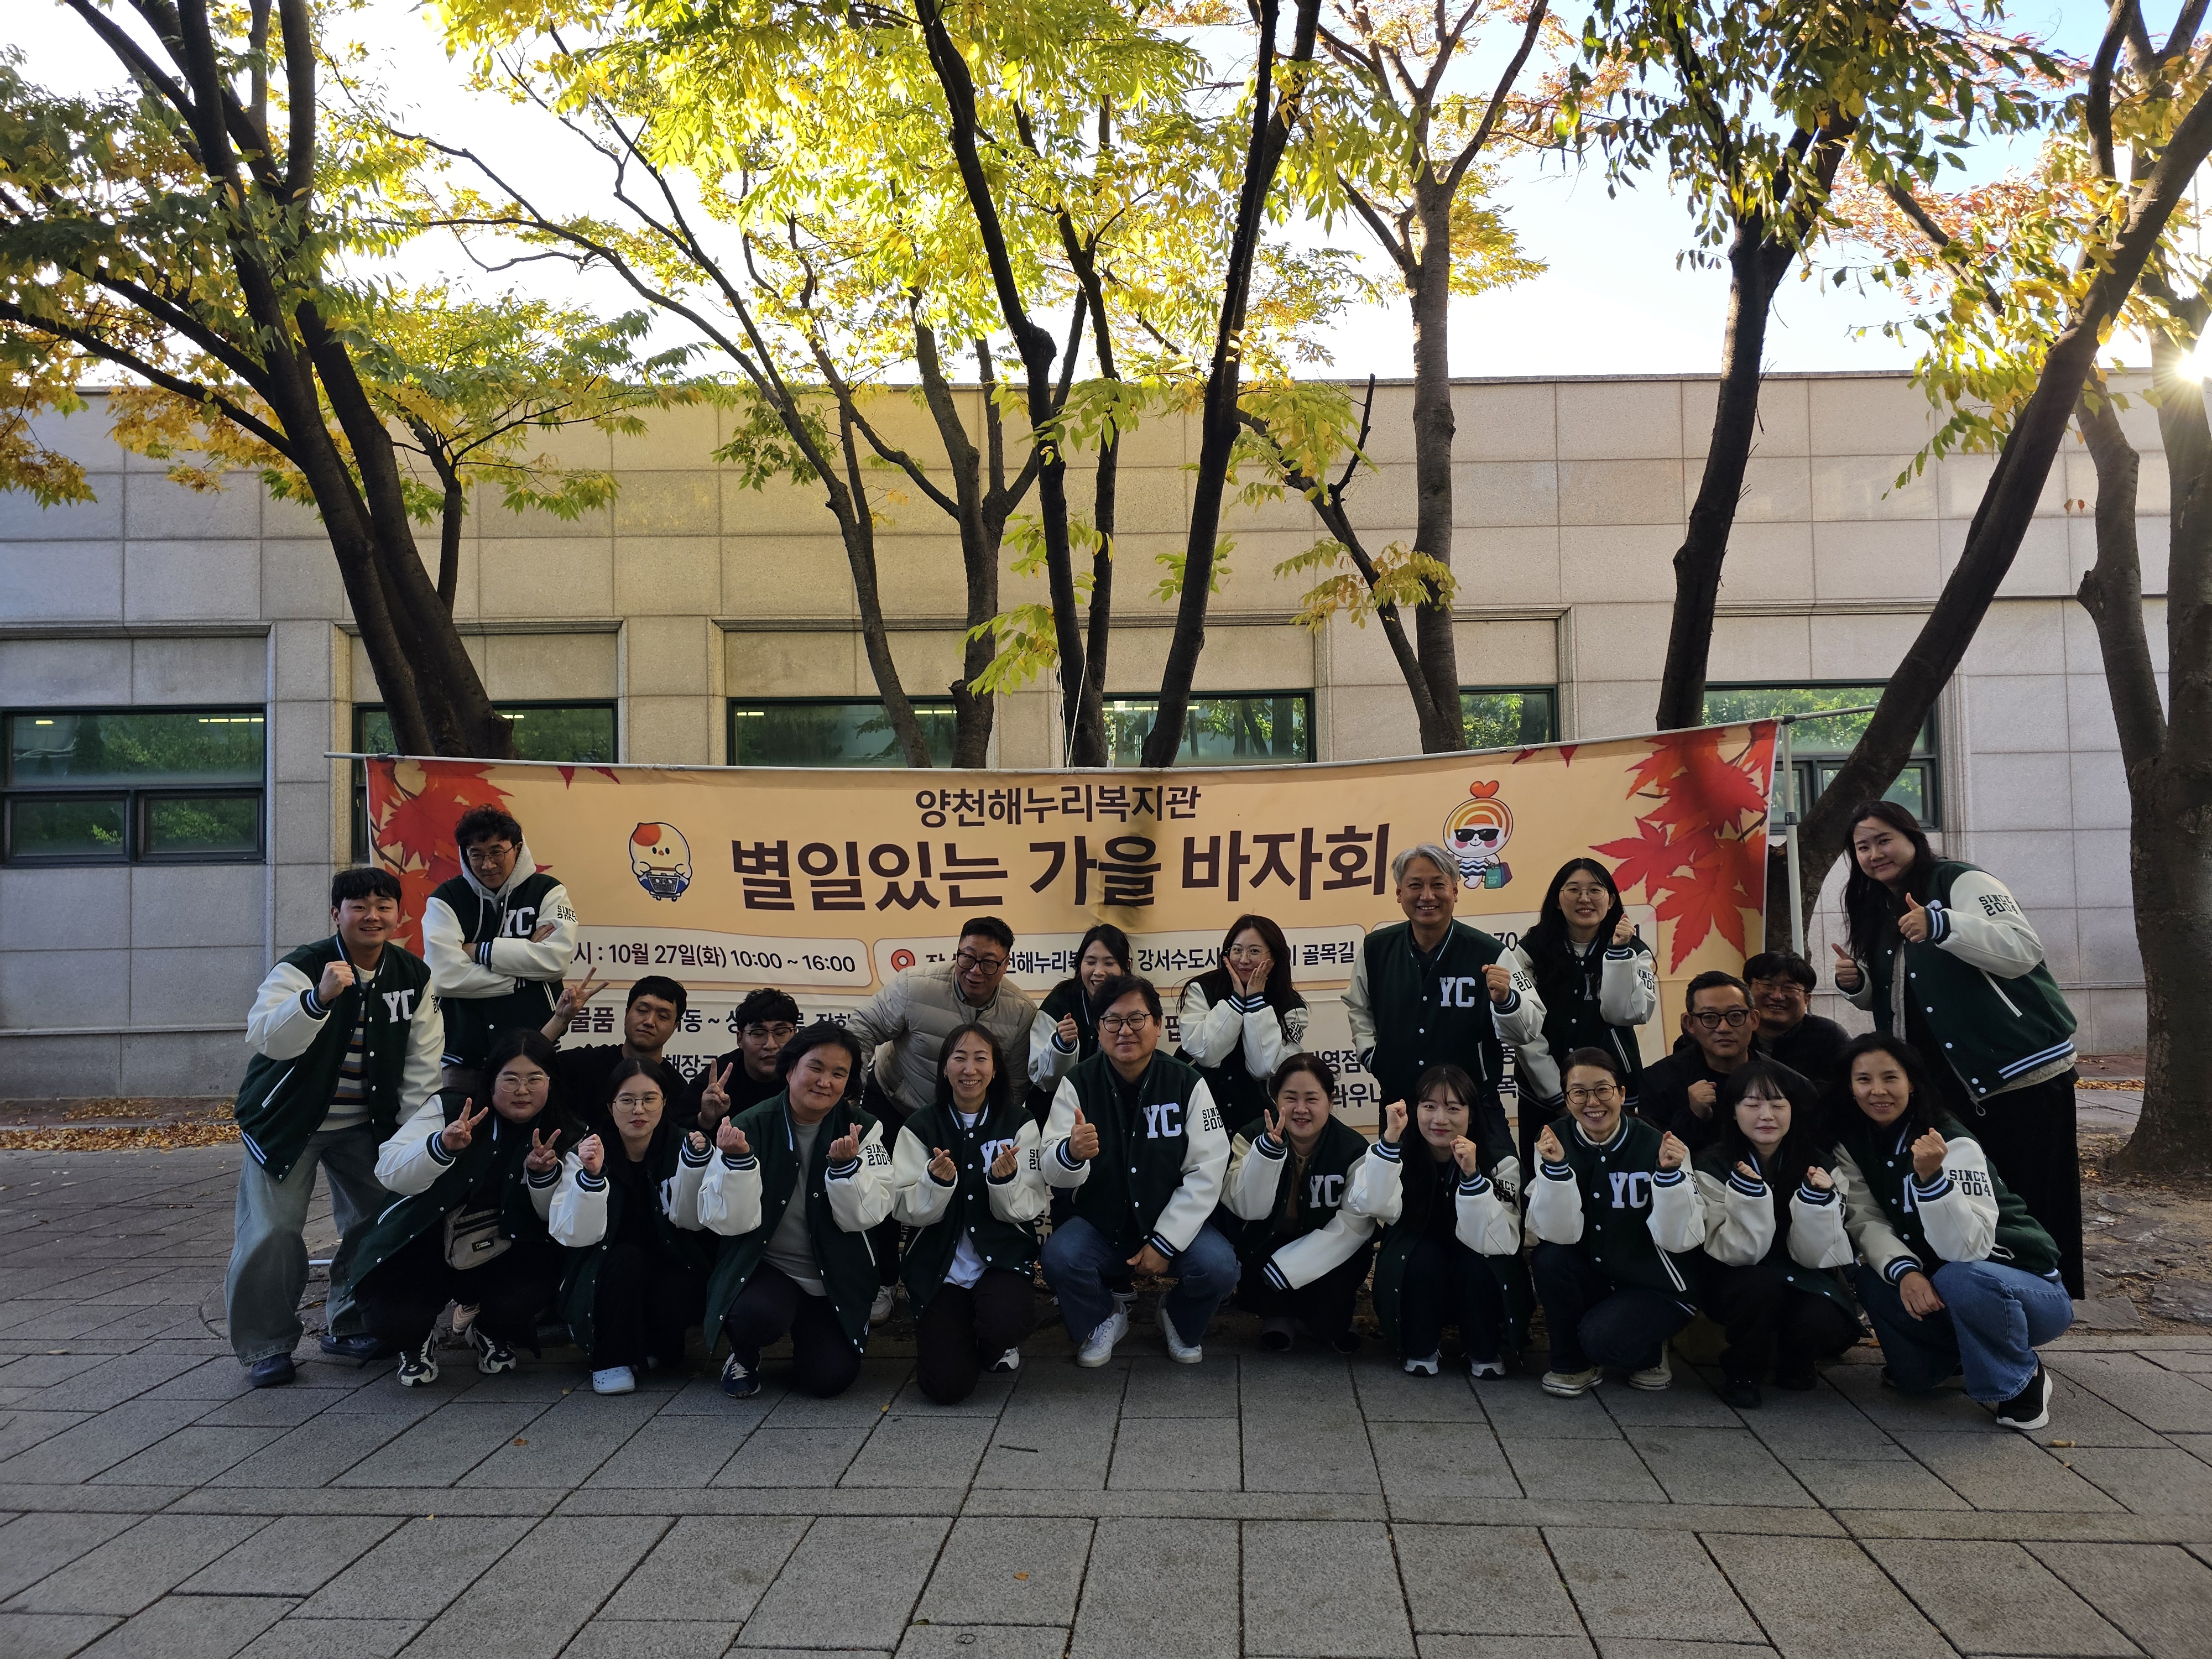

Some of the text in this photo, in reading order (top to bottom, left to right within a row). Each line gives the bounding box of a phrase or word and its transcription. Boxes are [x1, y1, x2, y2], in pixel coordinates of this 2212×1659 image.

[915, 784, 1201, 828] 양천해누리복지관
[731, 822, 1390, 911] 별일있는 가을 바자회
[1979, 894, 2013, 905] SINCE
[1983, 901, 2019, 917] 2004
[502, 906, 535, 937] YC
[608, 942, 649, 965] 10월
[654, 943, 727, 968] 27일(화)
[731, 950, 782, 969] 10:00
[802, 954, 855, 972] 16:00
[1302, 941, 1355, 966] 골목길
[382, 988, 415, 1024] YC
[1439, 977, 1475, 1008] YC
[1142, 1102, 1182, 1139] YC
[1203, 1117, 1224, 1132] 200
[1309, 1175, 1345, 1208] YC
[1608, 1171, 1651, 1209] YC
[1949, 1169, 1988, 1183] SINCE
[1957, 1181, 1992, 1197] 004
